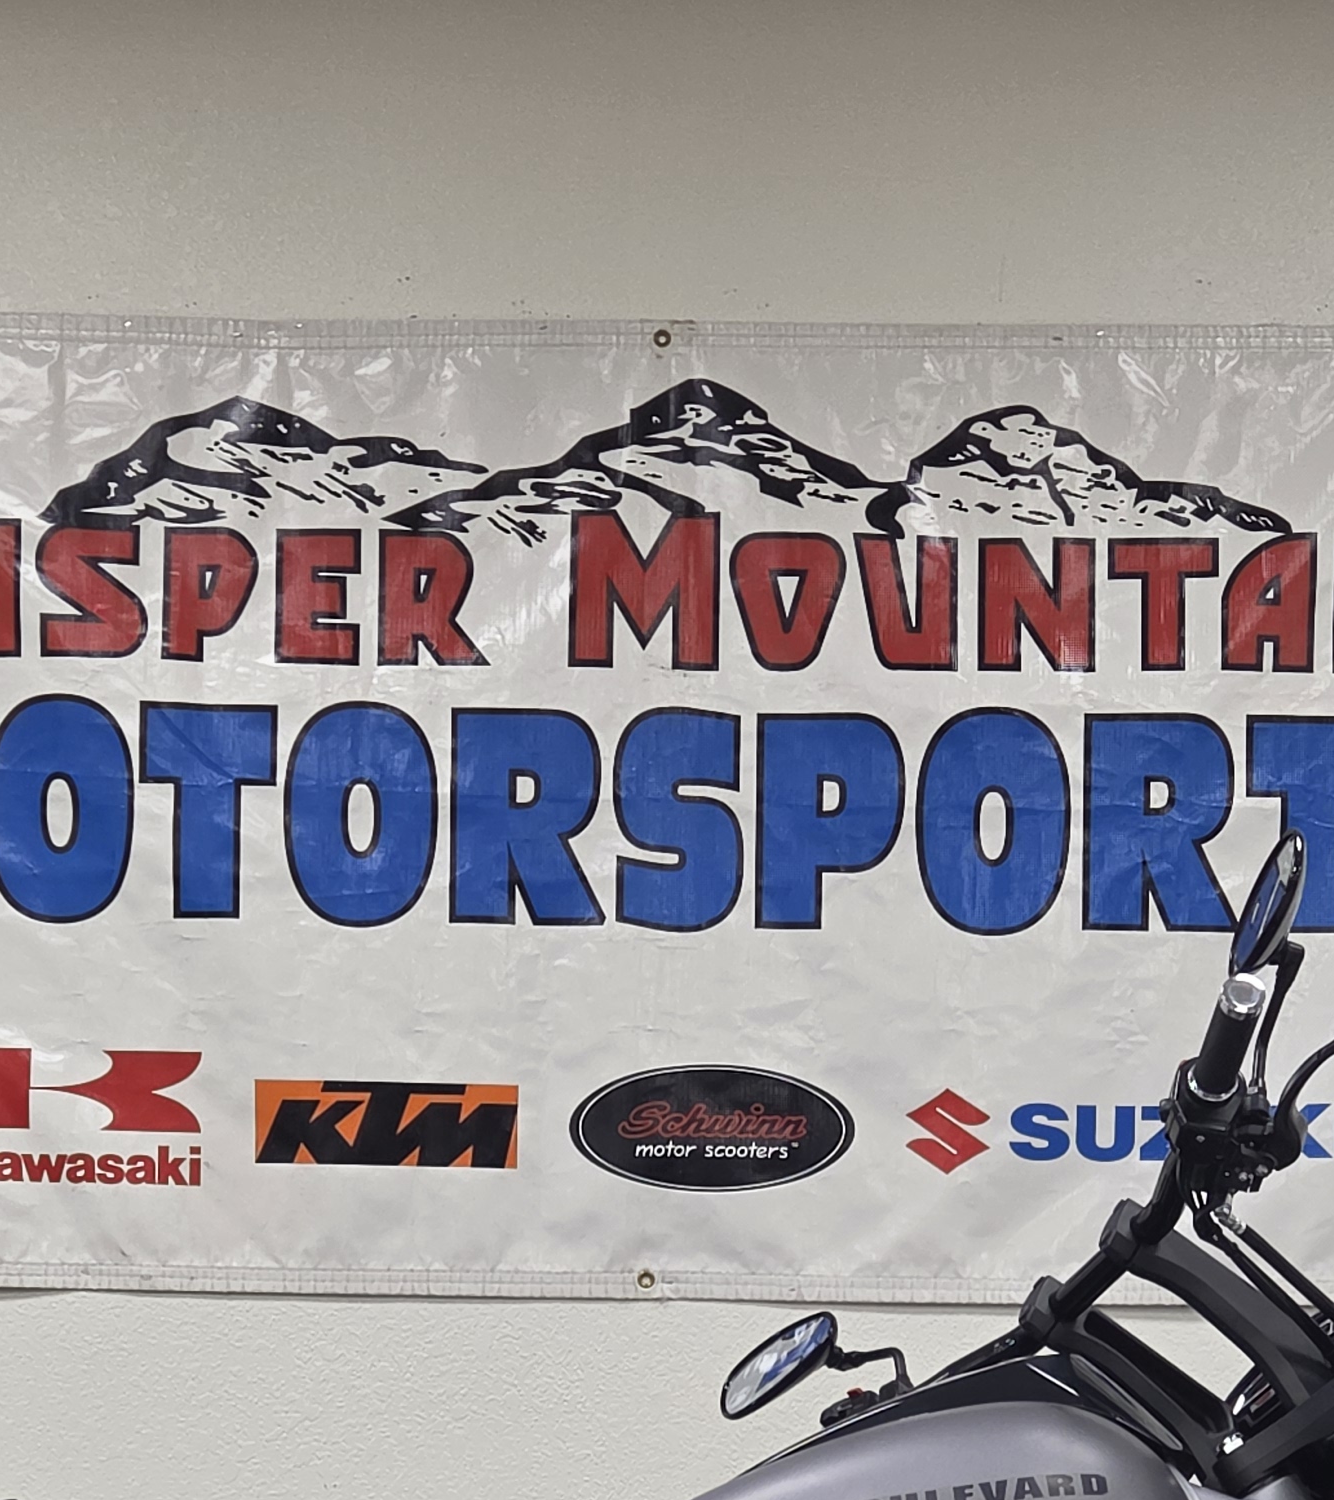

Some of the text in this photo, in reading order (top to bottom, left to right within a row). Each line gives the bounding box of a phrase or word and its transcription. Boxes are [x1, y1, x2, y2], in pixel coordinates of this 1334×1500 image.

[255, 1080, 519, 1169] KTM
[618, 1100, 807, 1139] Schwinn
[634, 1140, 697, 1158] motor
